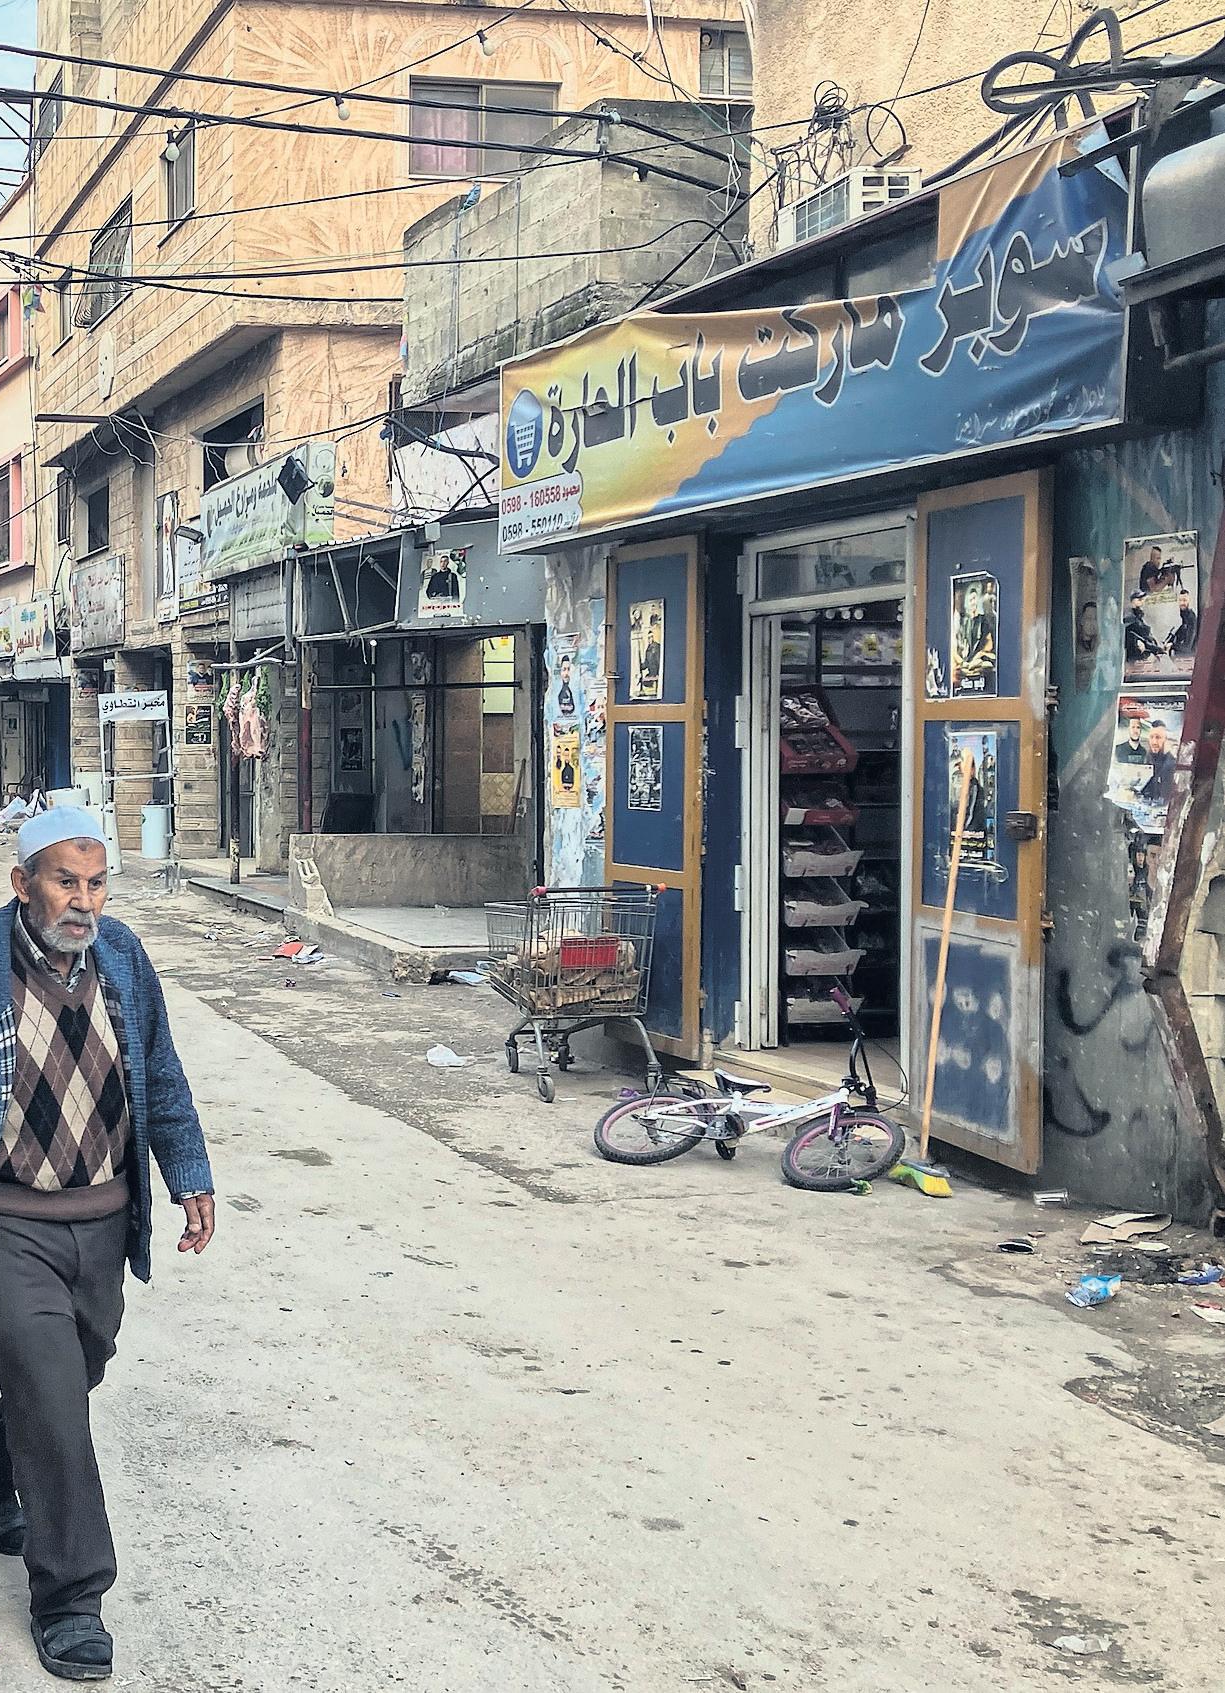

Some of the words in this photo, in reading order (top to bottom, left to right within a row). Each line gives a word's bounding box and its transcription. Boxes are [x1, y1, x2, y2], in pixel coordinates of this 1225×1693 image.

[922, 216, 1110, 377] سوبر
[653, 325, 723, 448] باب
[737, 297, 904, 406] ماركت
[546, 349, 639, 474] الحارة
[501, 495, 522, 515] 0598
[529, 485, 562, 508] 160558
[502, 522, 523, 543] 0598
[141, 697, 166, 711] مخبز
